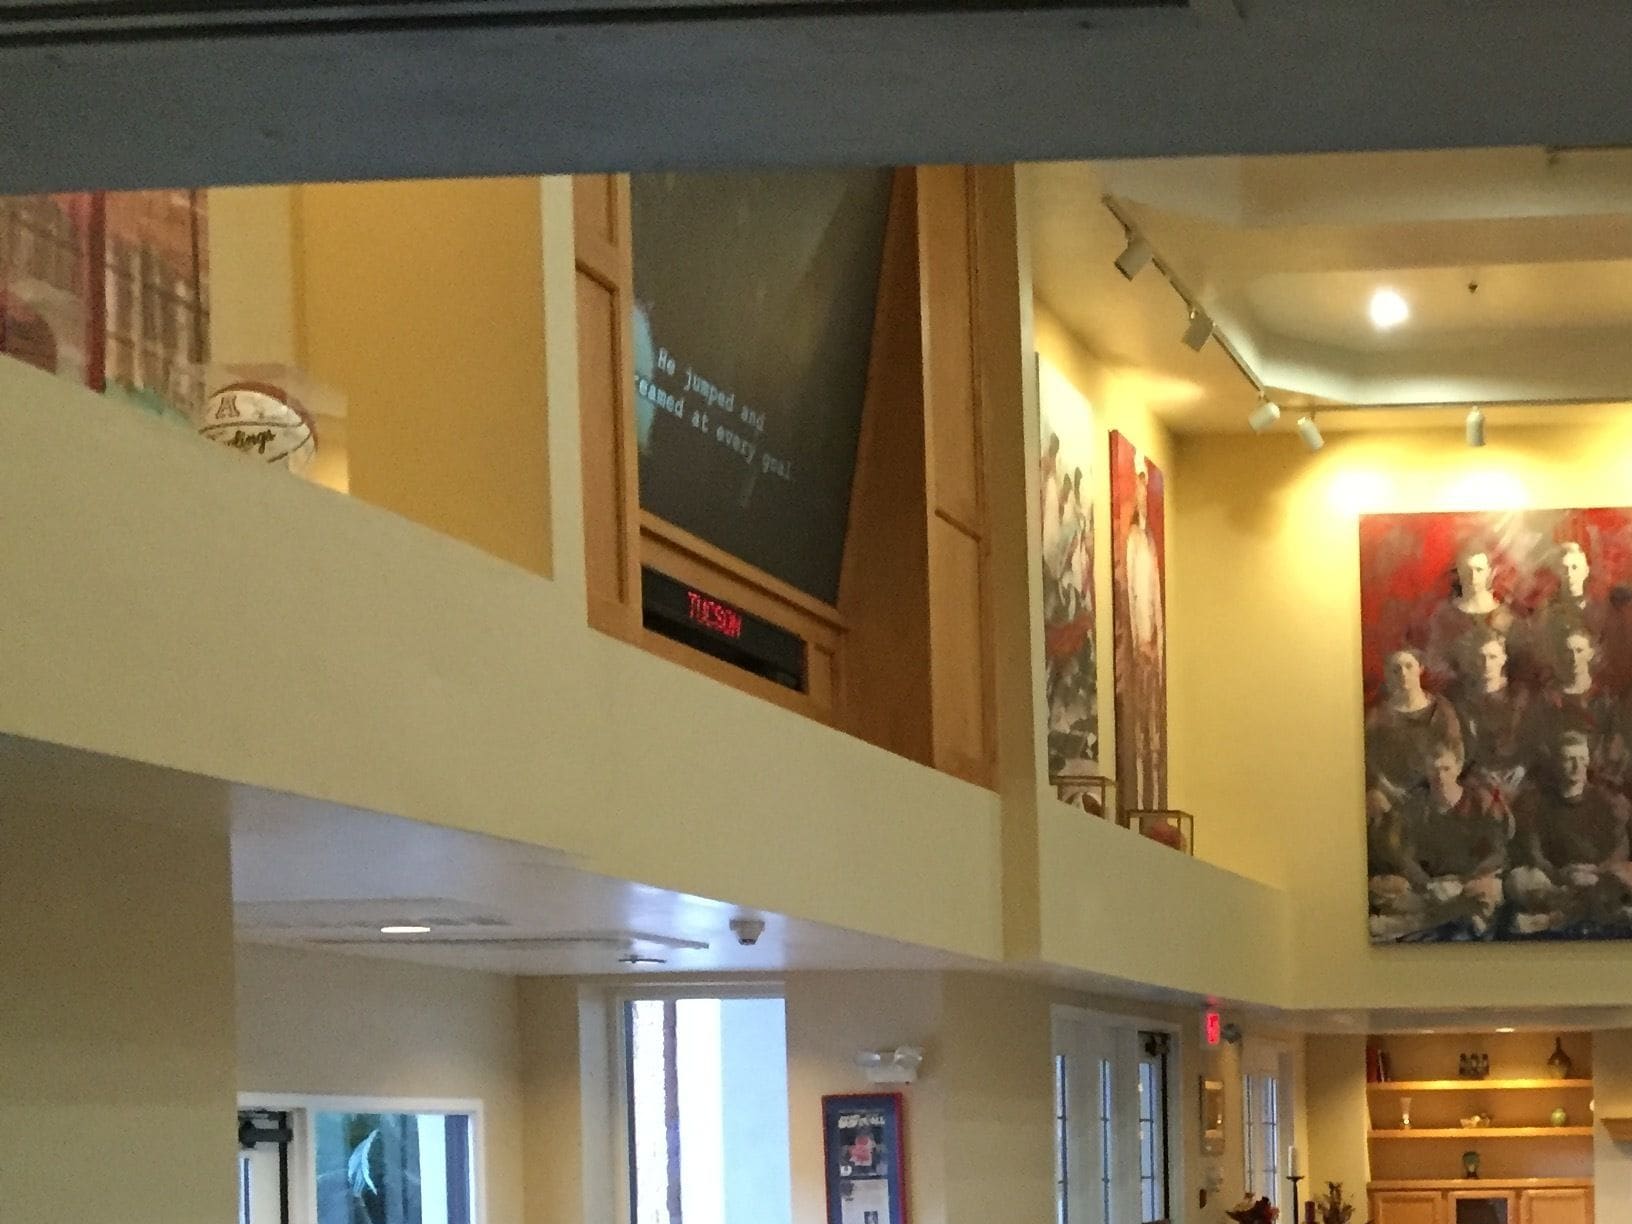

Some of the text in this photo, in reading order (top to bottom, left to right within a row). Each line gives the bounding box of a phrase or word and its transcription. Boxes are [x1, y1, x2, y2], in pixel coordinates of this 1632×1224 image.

[658, 347, 765, 432] He jumped and
[691, 410, 709, 433] at
[716, 425, 756, 464] every
